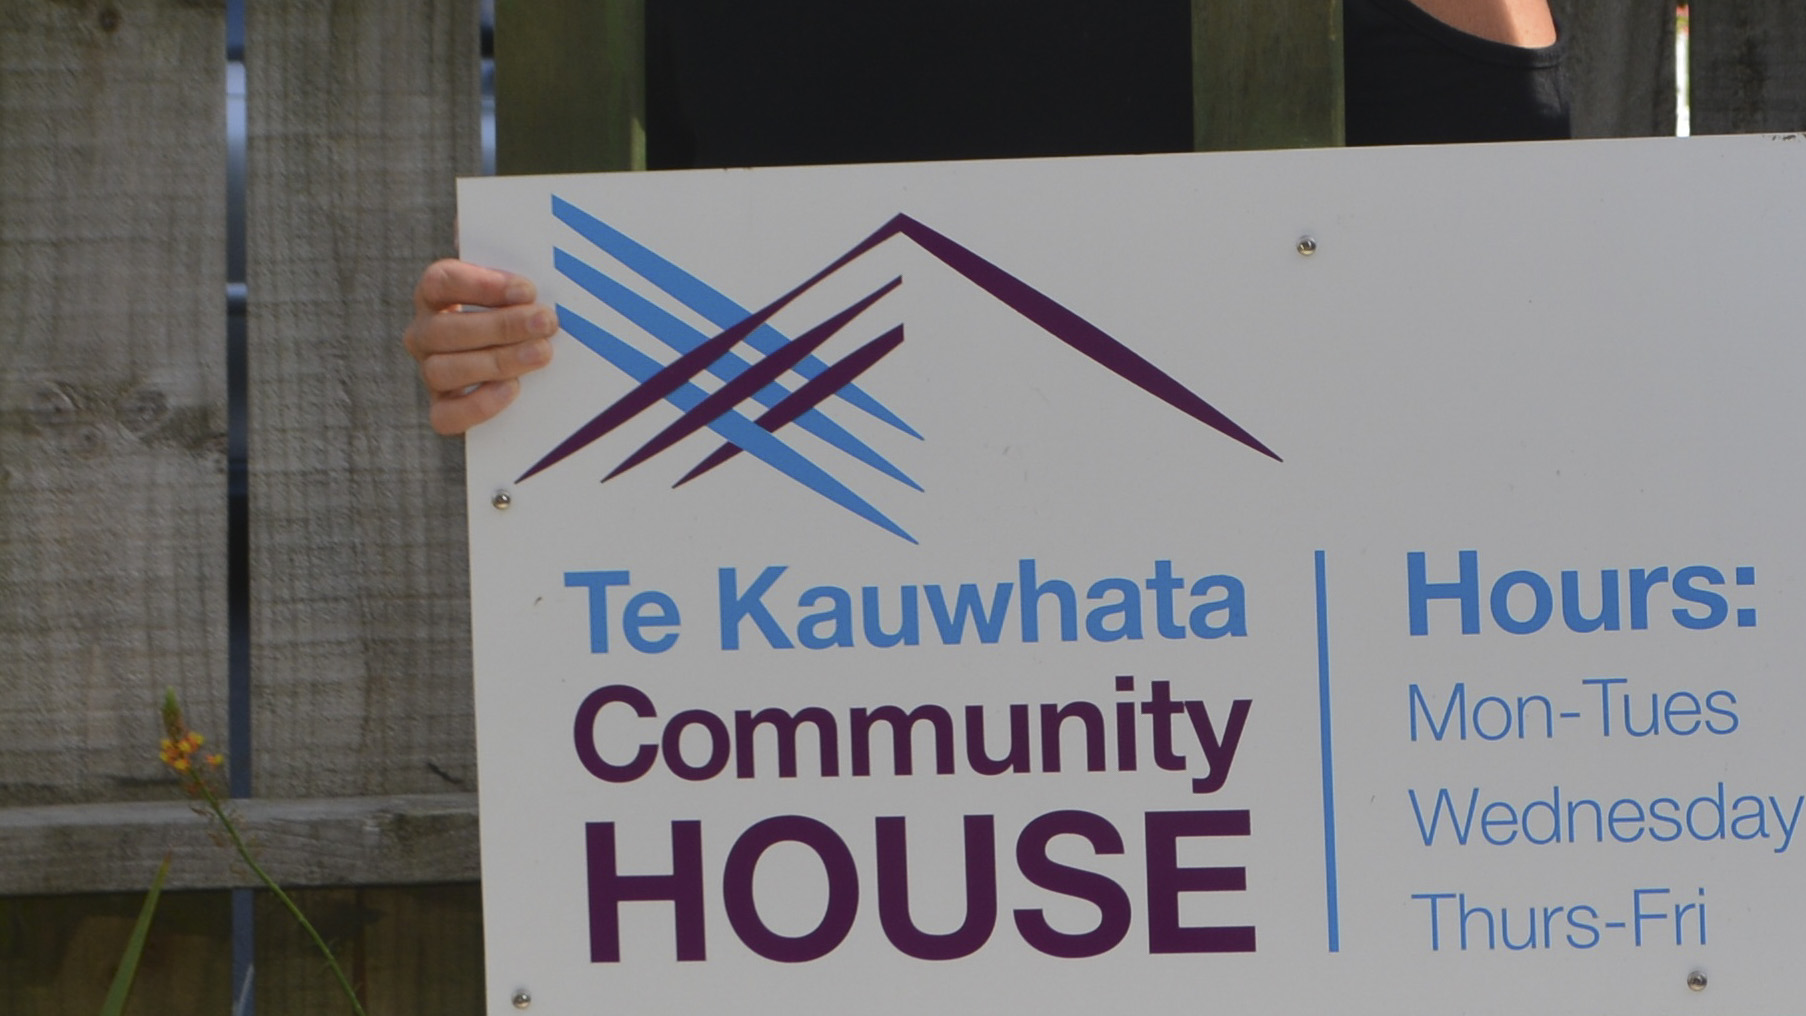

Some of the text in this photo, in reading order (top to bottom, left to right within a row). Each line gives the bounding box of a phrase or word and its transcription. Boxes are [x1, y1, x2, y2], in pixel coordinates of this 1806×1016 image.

[564, 559, 1247, 654] Te Kauwhata
[1407, 550, 1756, 636] Hours:
[574, 676, 1252, 793] Community
[1409, 678, 1738, 741] Mon-Tues
[1408, 782, 1804, 853] Wednesday
[585, 810, 1256, 963] HOUSE
[1411, 888, 1706, 951] Thurs-Fri
